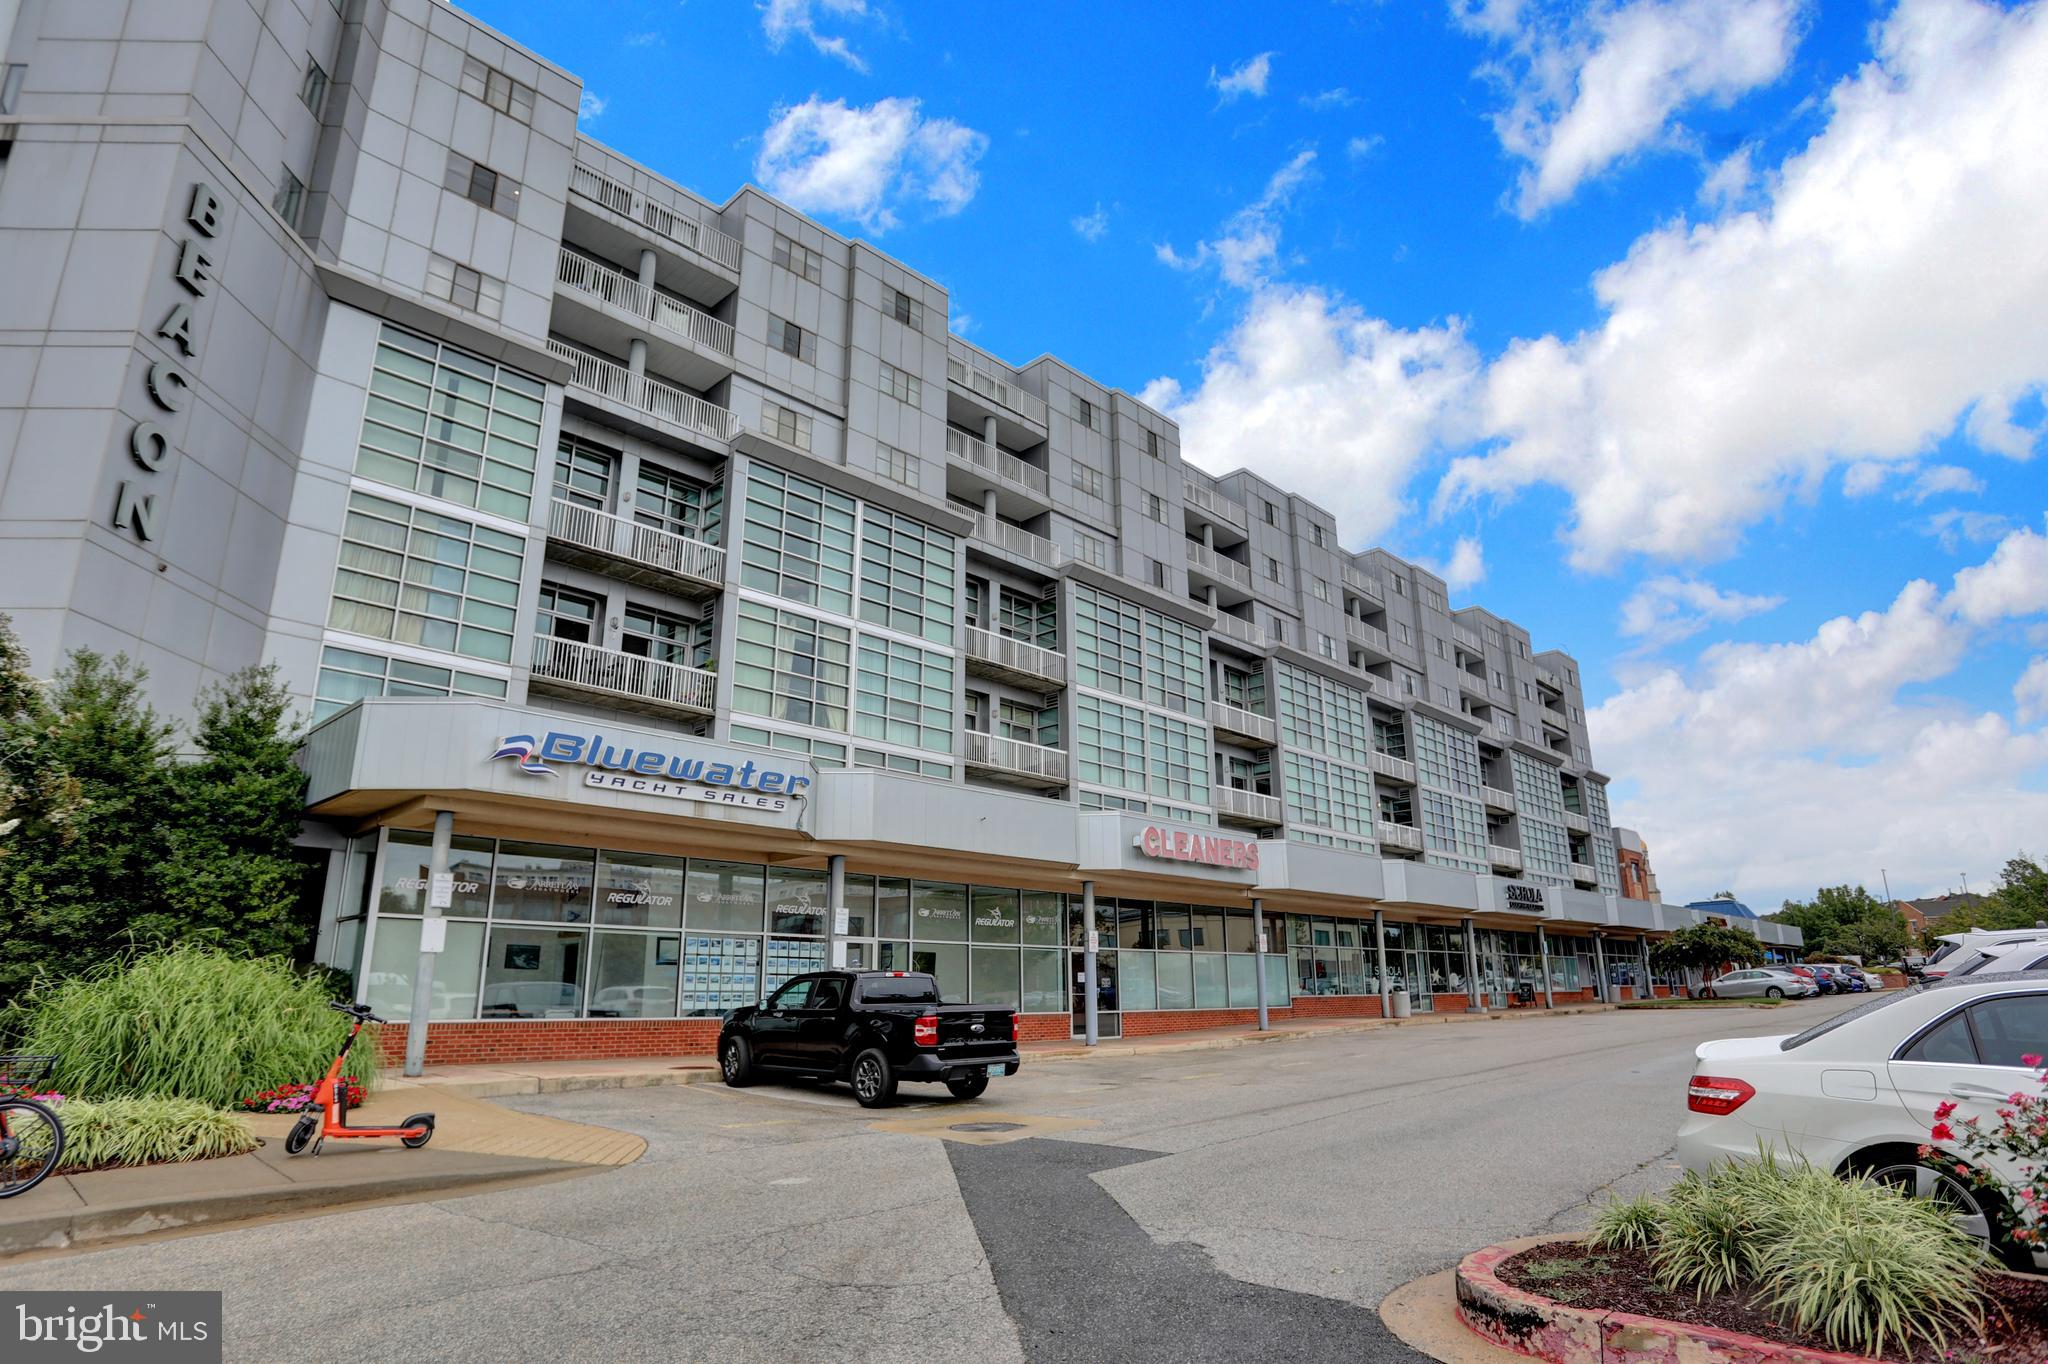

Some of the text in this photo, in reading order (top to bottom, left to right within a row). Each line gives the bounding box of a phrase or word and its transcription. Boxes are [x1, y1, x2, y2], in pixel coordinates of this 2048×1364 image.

[113, 182, 224, 542] BEACON
[539, 731, 810, 796] Bluewater
[590, 772, 786, 810] YACHT SALES
[1142, 825, 1260, 872] CLEANERS
[395, 877, 479, 894] REGTOR
[607, 892, 673, 906] REGULATOR
[975, 917, 1015, 928] REGULATOR
